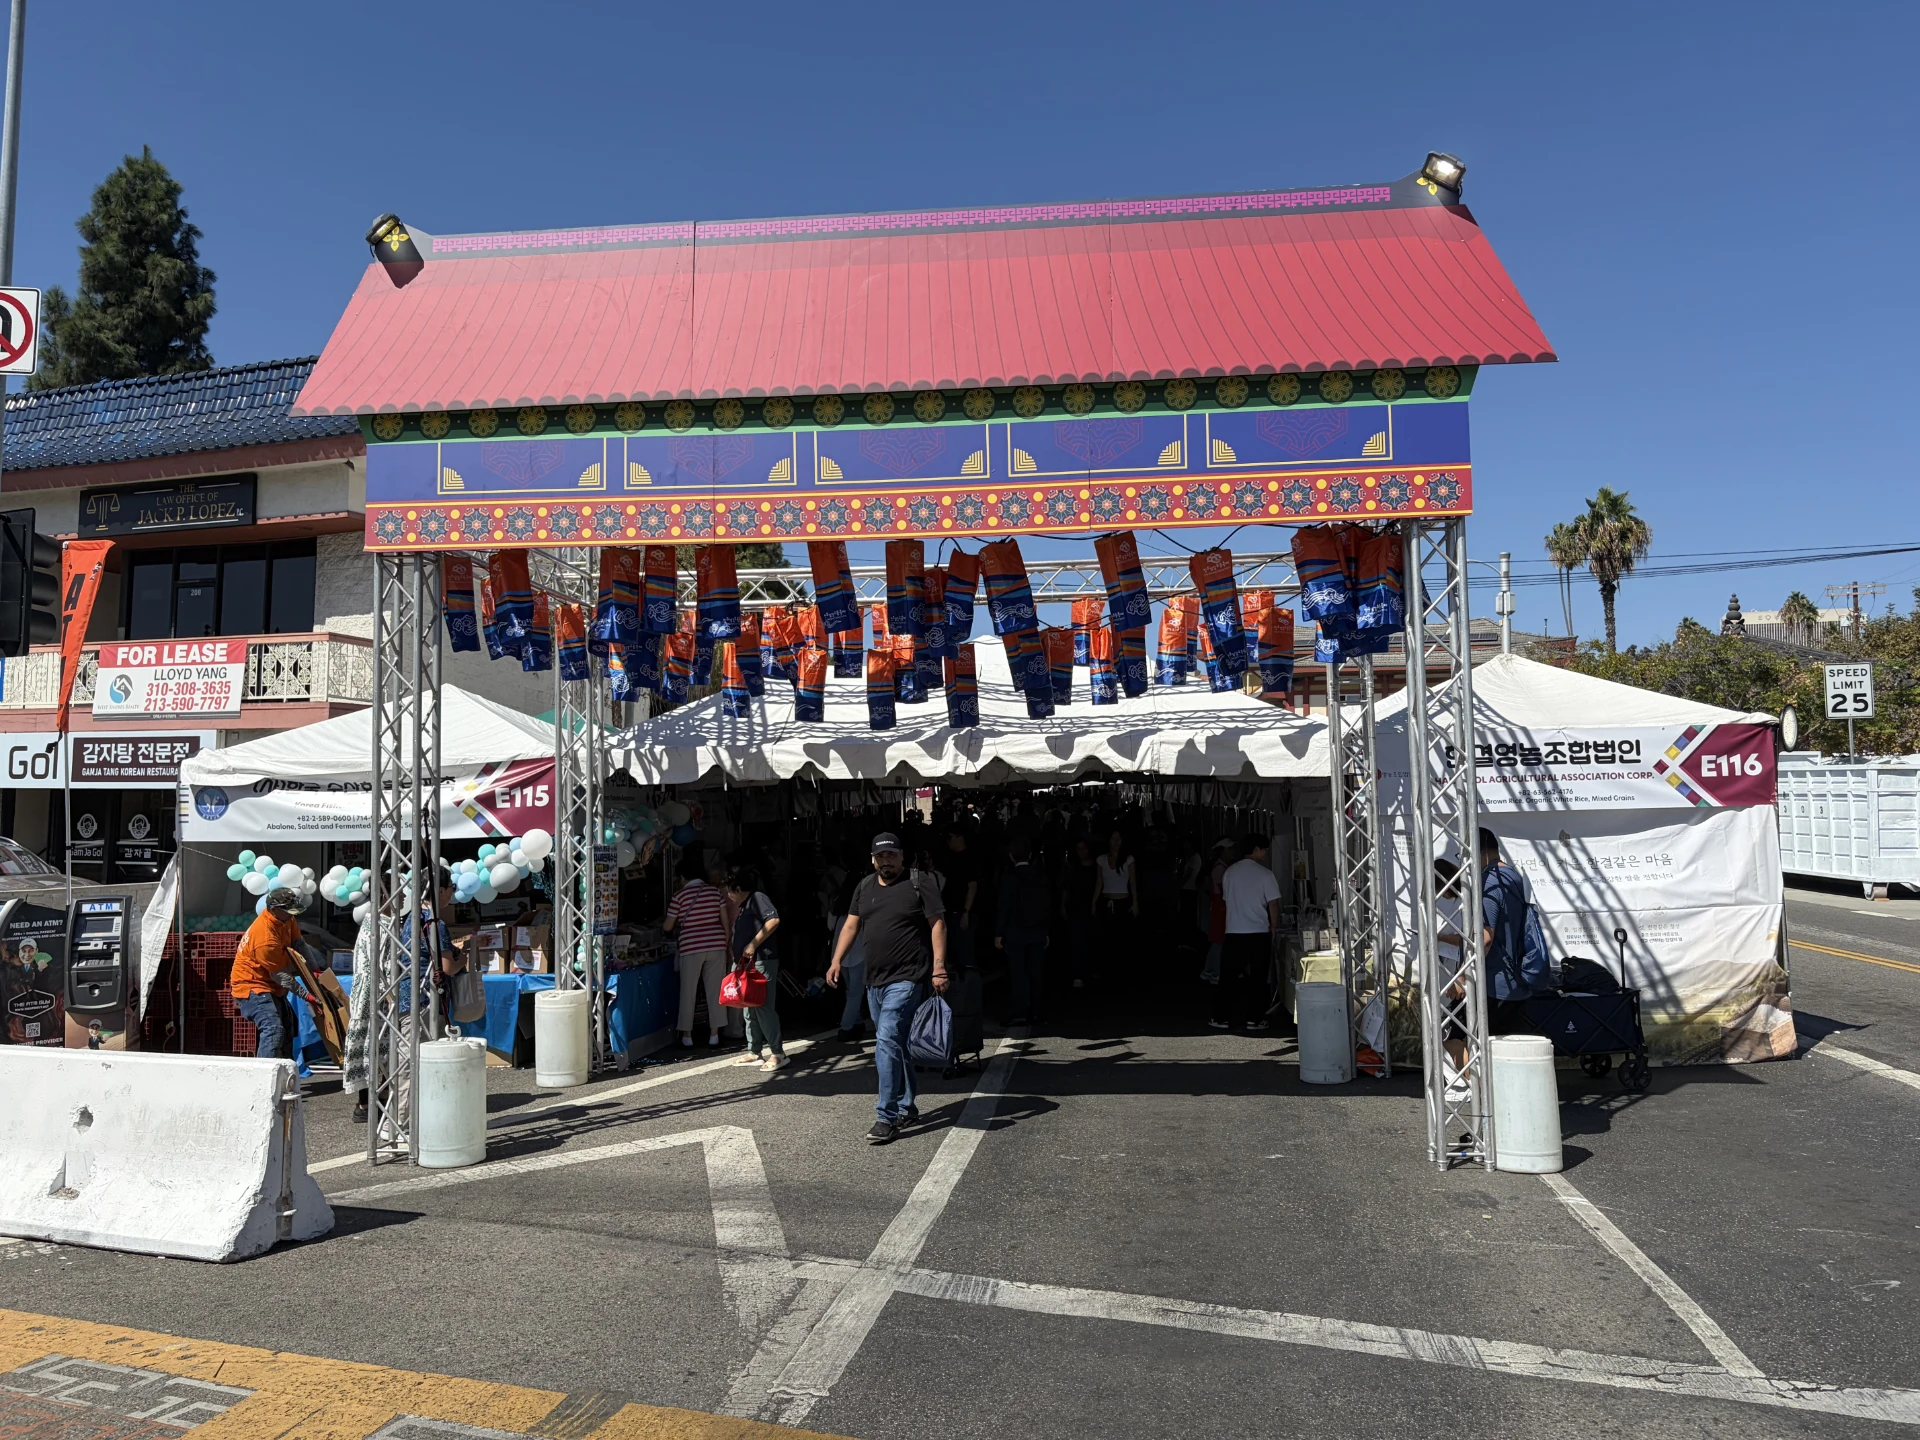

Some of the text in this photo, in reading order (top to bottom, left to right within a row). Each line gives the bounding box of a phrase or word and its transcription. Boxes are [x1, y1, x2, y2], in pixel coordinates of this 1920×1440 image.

[179, 484, 195, 493] THE
[156, 492, 219, 506] LAW OFFICE OF
[138, 508, 174, 525] JACK
[176, 508, 186, 522] P.
[189, 502, 236, 521] LOPEZ
[190, 588, 202, 597] 208
[116, 643, 228, 666] FOR LEASE
[154, 667, 228, 681] LLOYD YANG
[1828, 668, 1869, 678] SPEED
[146, 681, 231, 697] 310-308-3635
[1832, 680, 1865, 690] LIMIT
[144, 696, 230, 712] 213-590-7797
[1830, 693, 1869, 713] 25
[82, 742, 190, 764] 감자탕 전문점
[82, 767, 179, 776] GAMJA TANG KOREAN RESTAURA
[1701, 753, 1763, 777] E116
[1488, 774, 1560, 784] AGRICULTURAL
[1560, 772, 1625, 782] ASSOCIATION
[1627, 771, 1655, 780] CORP.
[494, 785, 550, 809] E115
[1518, 788, 1574, 796] +82-63-562-4176
[1486, 797, 1508, 805] Brown
[1525, 796, 1553, 804] Organic
[1554, 795, 1574, 803] White
[1574, 795, 1590, 803] Rice,
[1613, 794, 1635, 802] Grains
[266, 823, 296, 831] Abalone,
[335, 822, 371, 830] Fermented
[1645, 853, 1674, 867] 마음
[89, 903, 114, 911] ATM
[9, 921, 31, 929] NEED
[32, 920, 43, 928] AN
[35, 1037, 64, 1046] PROVIDER
